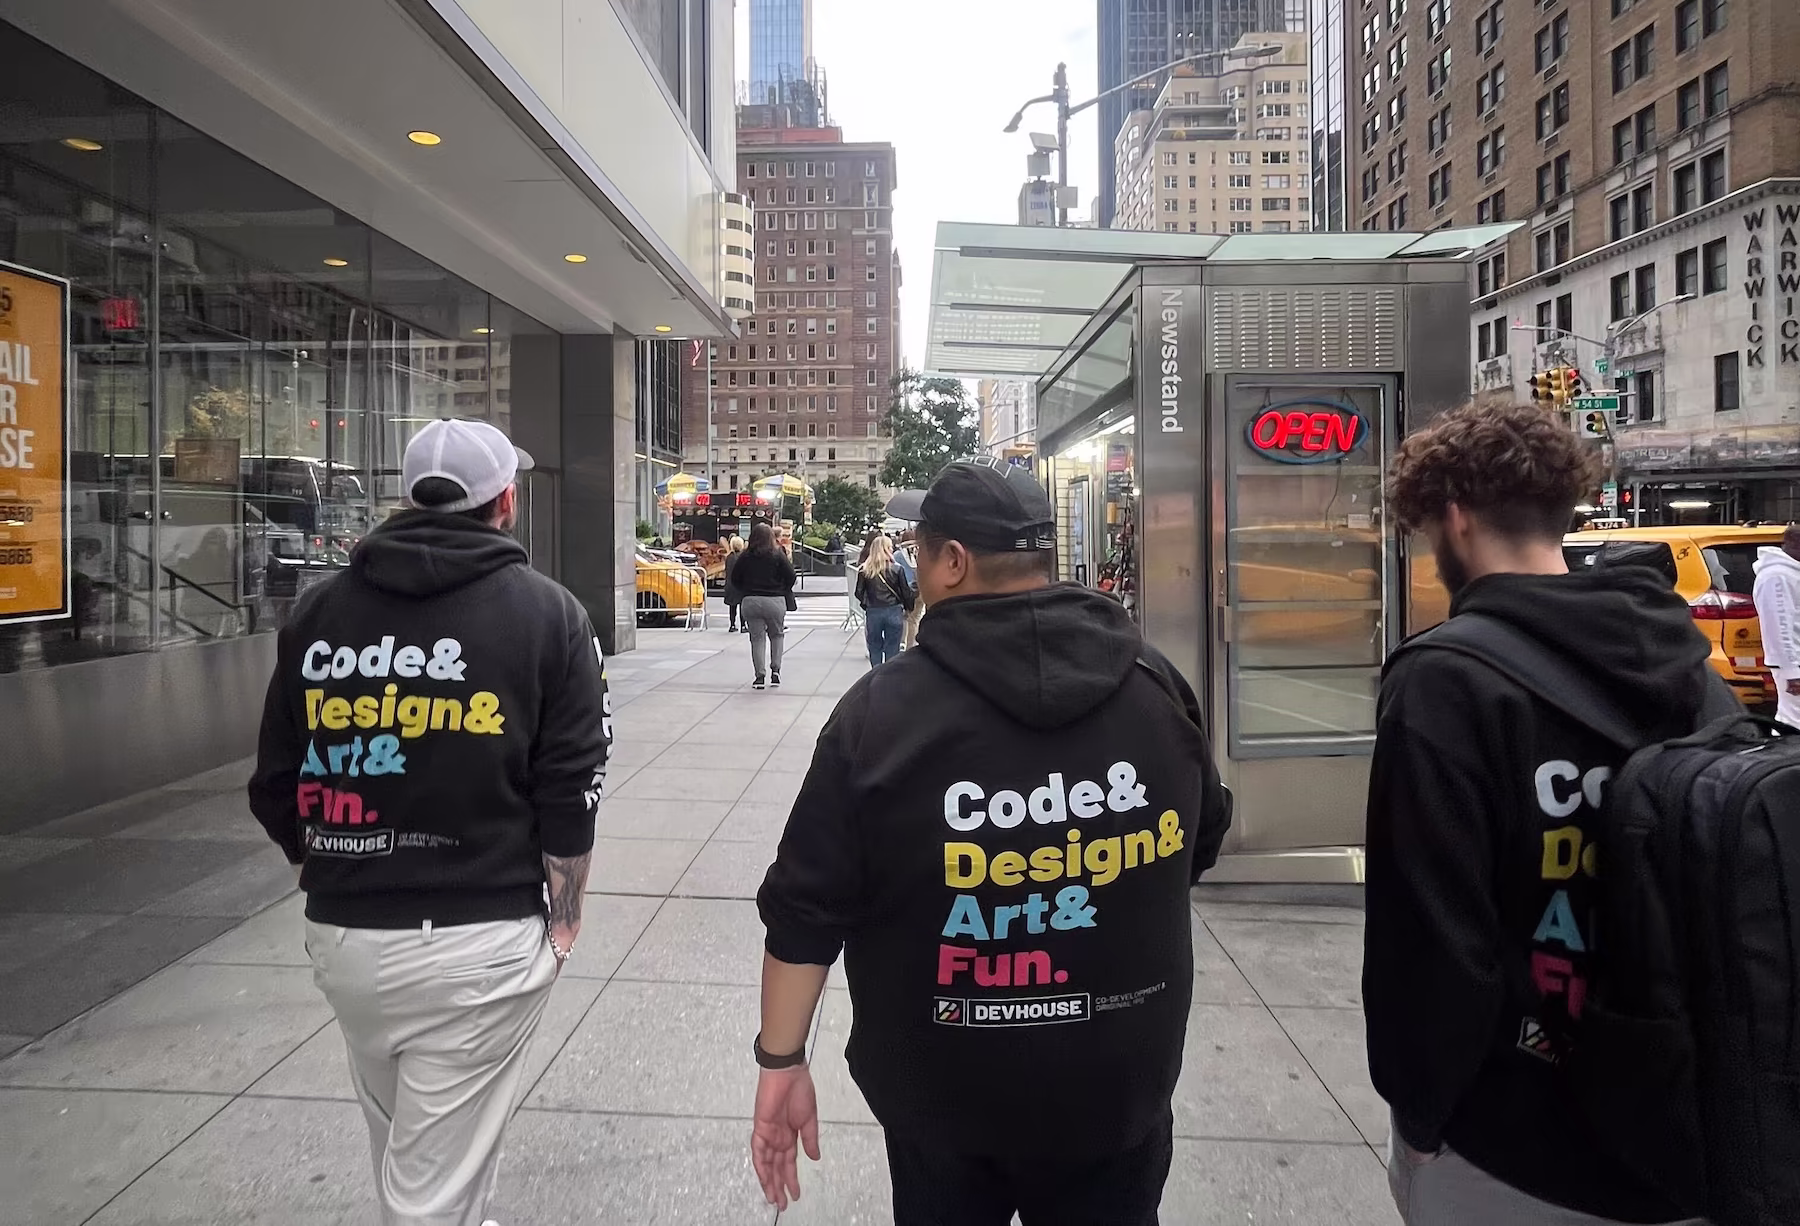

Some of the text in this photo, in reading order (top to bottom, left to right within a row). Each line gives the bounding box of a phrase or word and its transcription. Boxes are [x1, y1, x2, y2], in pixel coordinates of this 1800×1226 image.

[1743, 207, 1766, 368] WARWICK
[1776, 204, 1800, 364] WARWICK
[1161, 288, 1184, 433] Newsstand
[1253, 411, 1358, 452] OPEN
[1582, 400, 1592, 409] 54
[302, 635, 468, 681] Code&
[943, 760, 1149, 832] Code&
[944, 809, 1185, 889] Design&
[941, 885, 1098, 941] Art&
[937, 944, 1069, 987] Fun.
[975, 1000, 1083, 1021] DEVHOUSE
